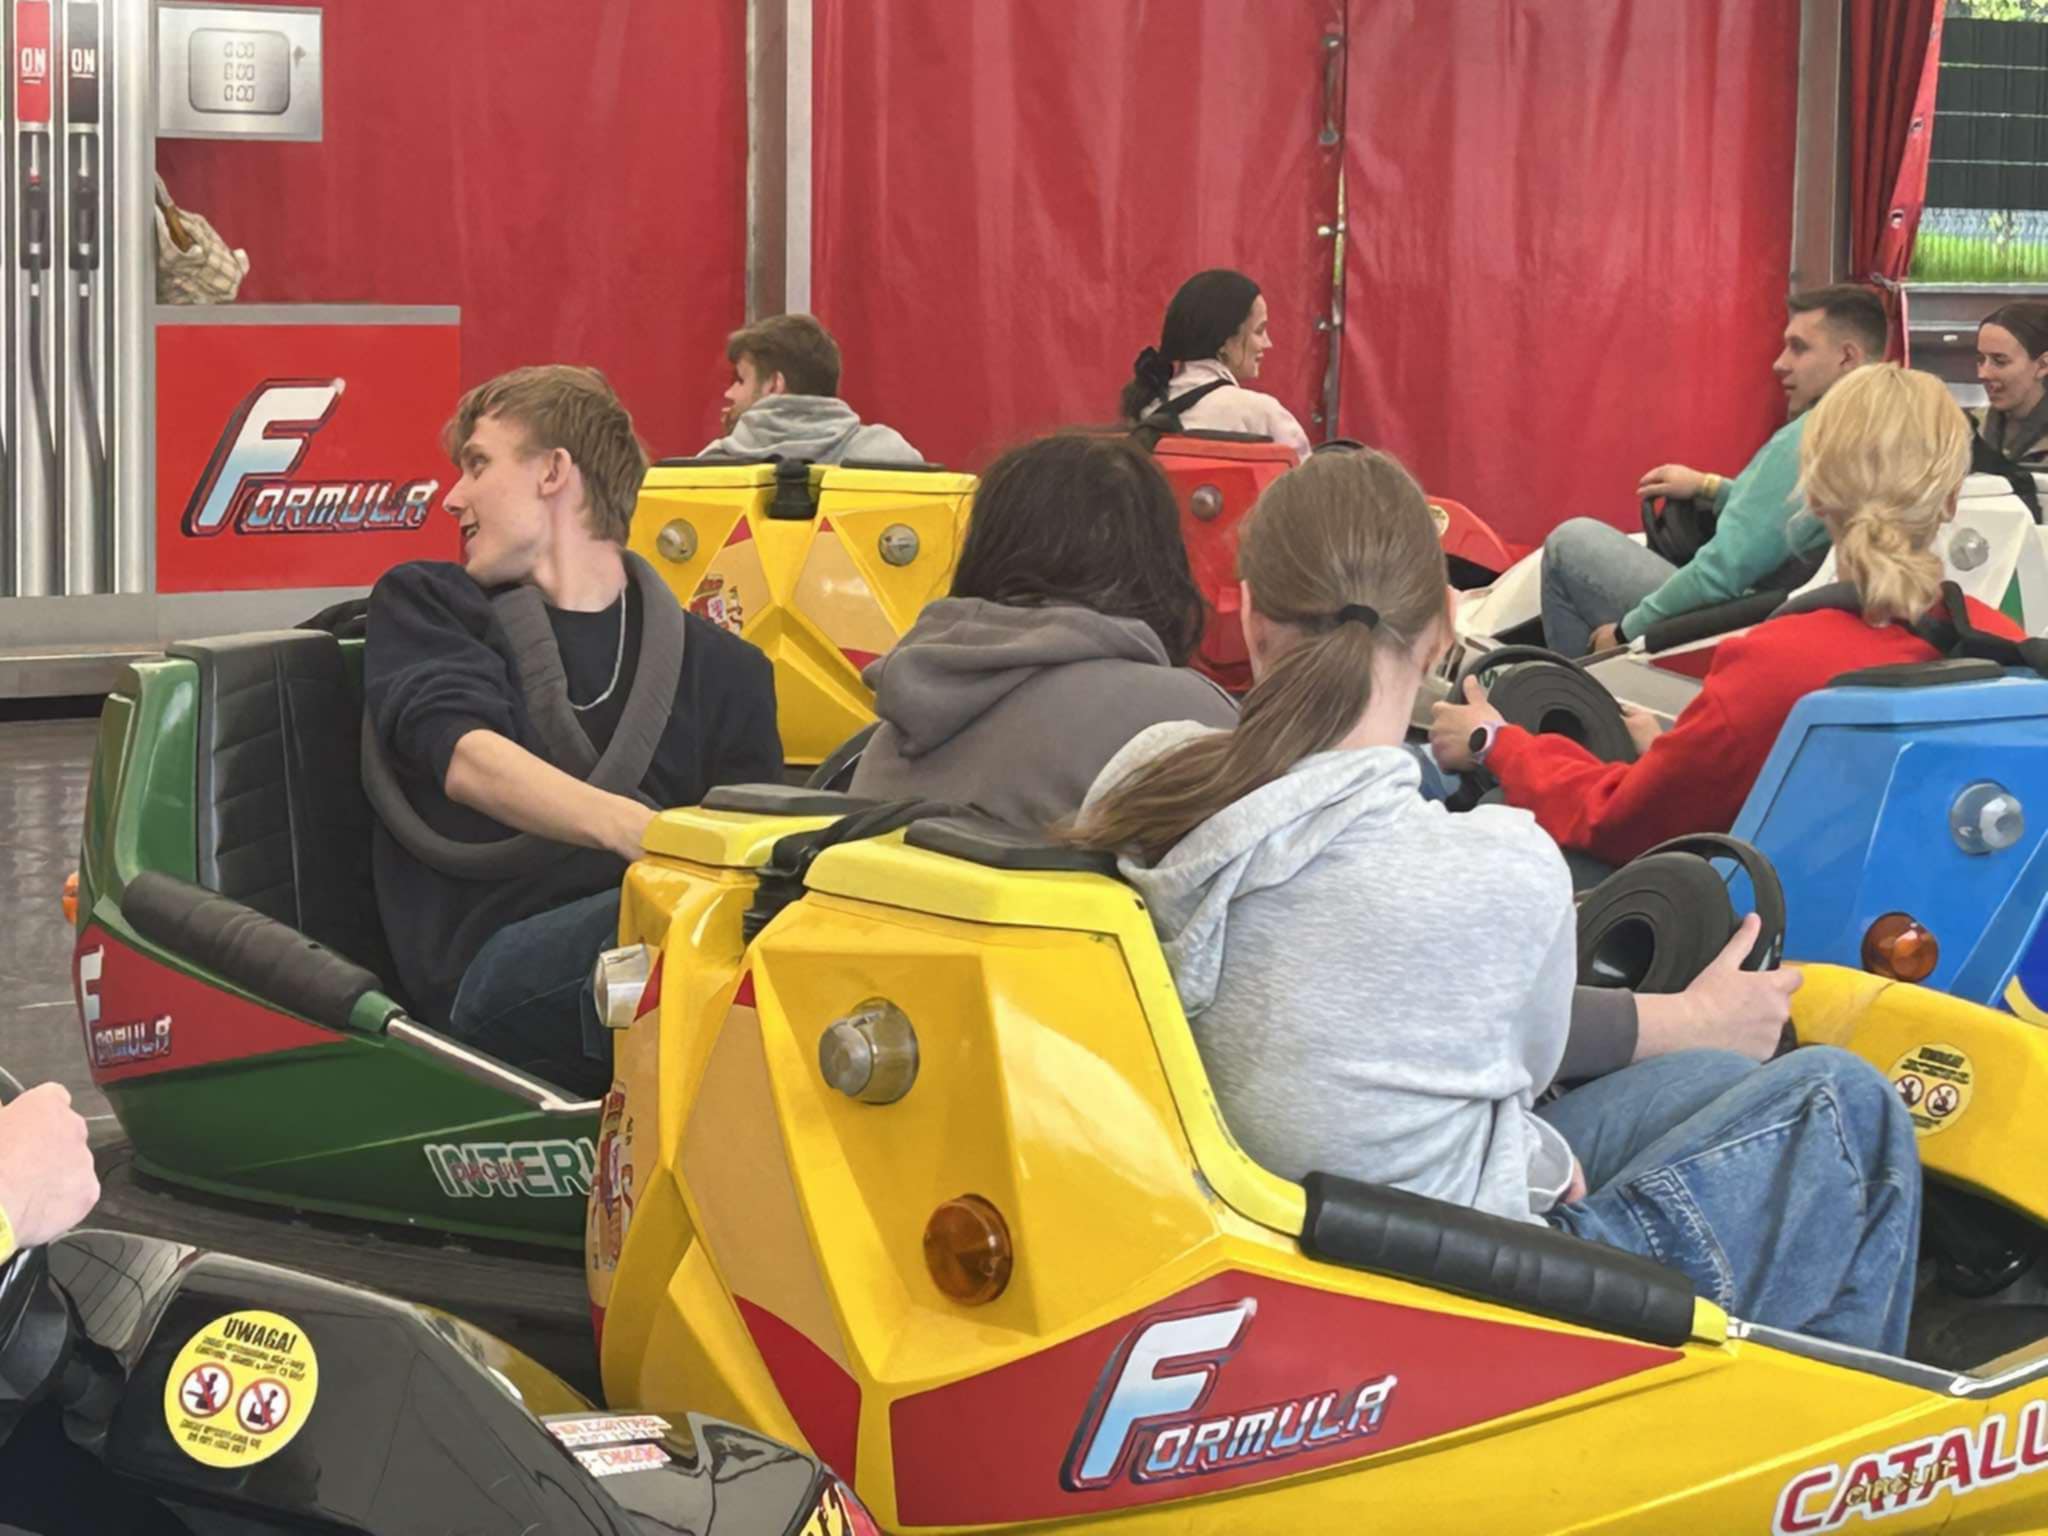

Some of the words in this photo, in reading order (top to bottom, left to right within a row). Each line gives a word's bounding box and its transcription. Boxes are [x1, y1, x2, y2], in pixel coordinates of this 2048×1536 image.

[22, 48, 47, 77] ON
[71, 48, 95, 73] ON
[182, 377, 440, 537] FORMULA
[223, 1317, 297, 1355] UWAGA!
[1060, 1297, 1398, 1492] FORMULA
